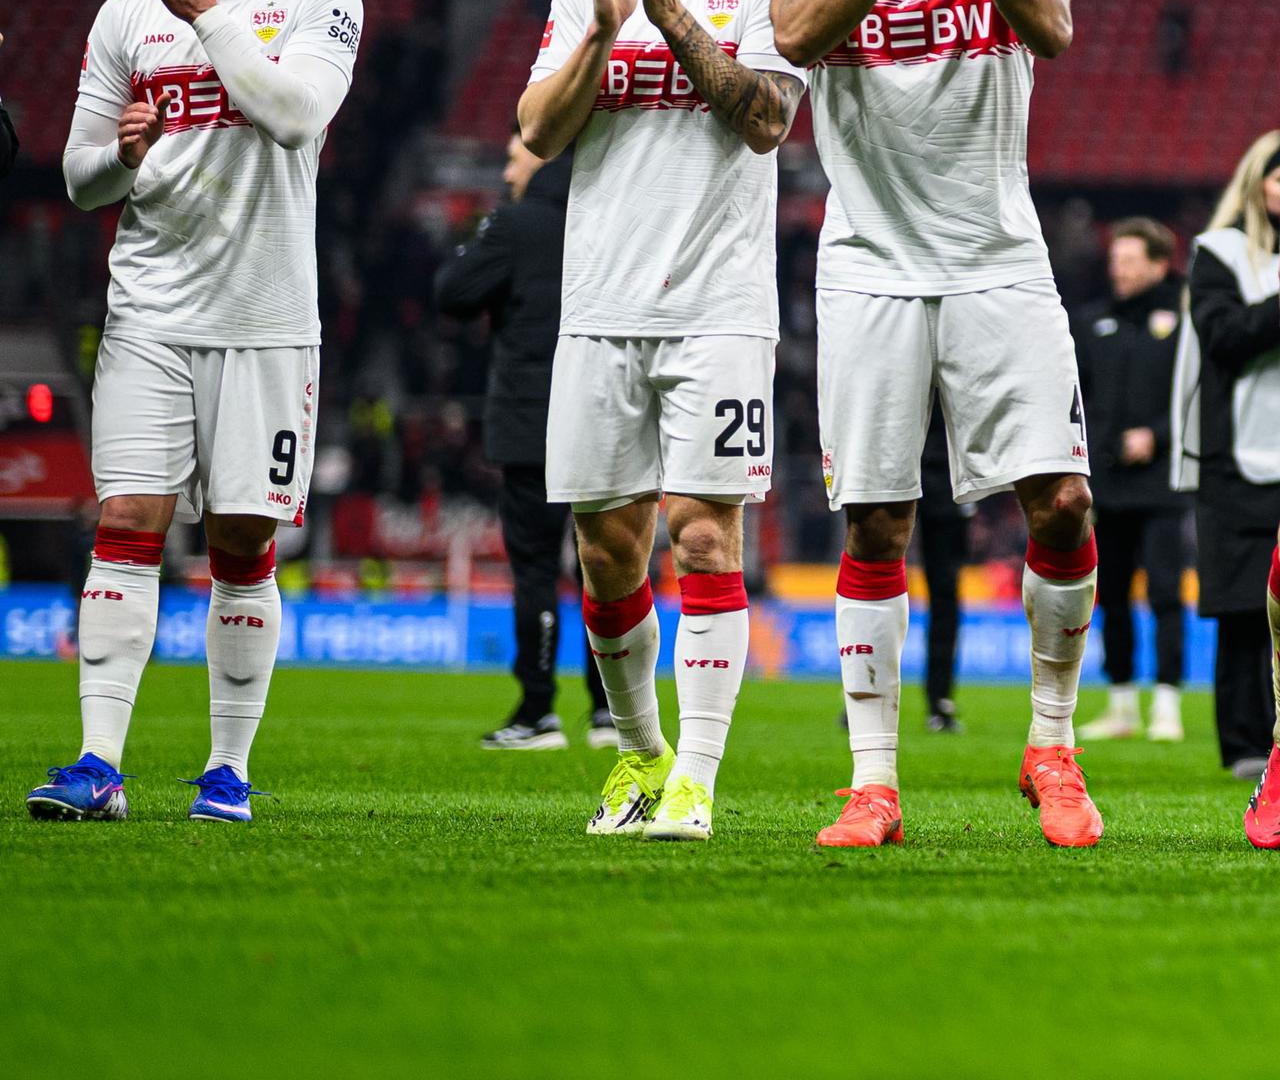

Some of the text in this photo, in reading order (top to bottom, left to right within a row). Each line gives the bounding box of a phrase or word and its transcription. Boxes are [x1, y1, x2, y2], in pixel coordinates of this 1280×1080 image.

[143, 34, 175, 45] JAKO
[714, 399, 764, 457] 29
[268, 430, 297, 486] 9
[747, 466, 771, 476] JAKO
[267, 492, 292, 506] JAKO
[218, 614, 263, 628] VfB
[684, 659, 729, 669] VfB
